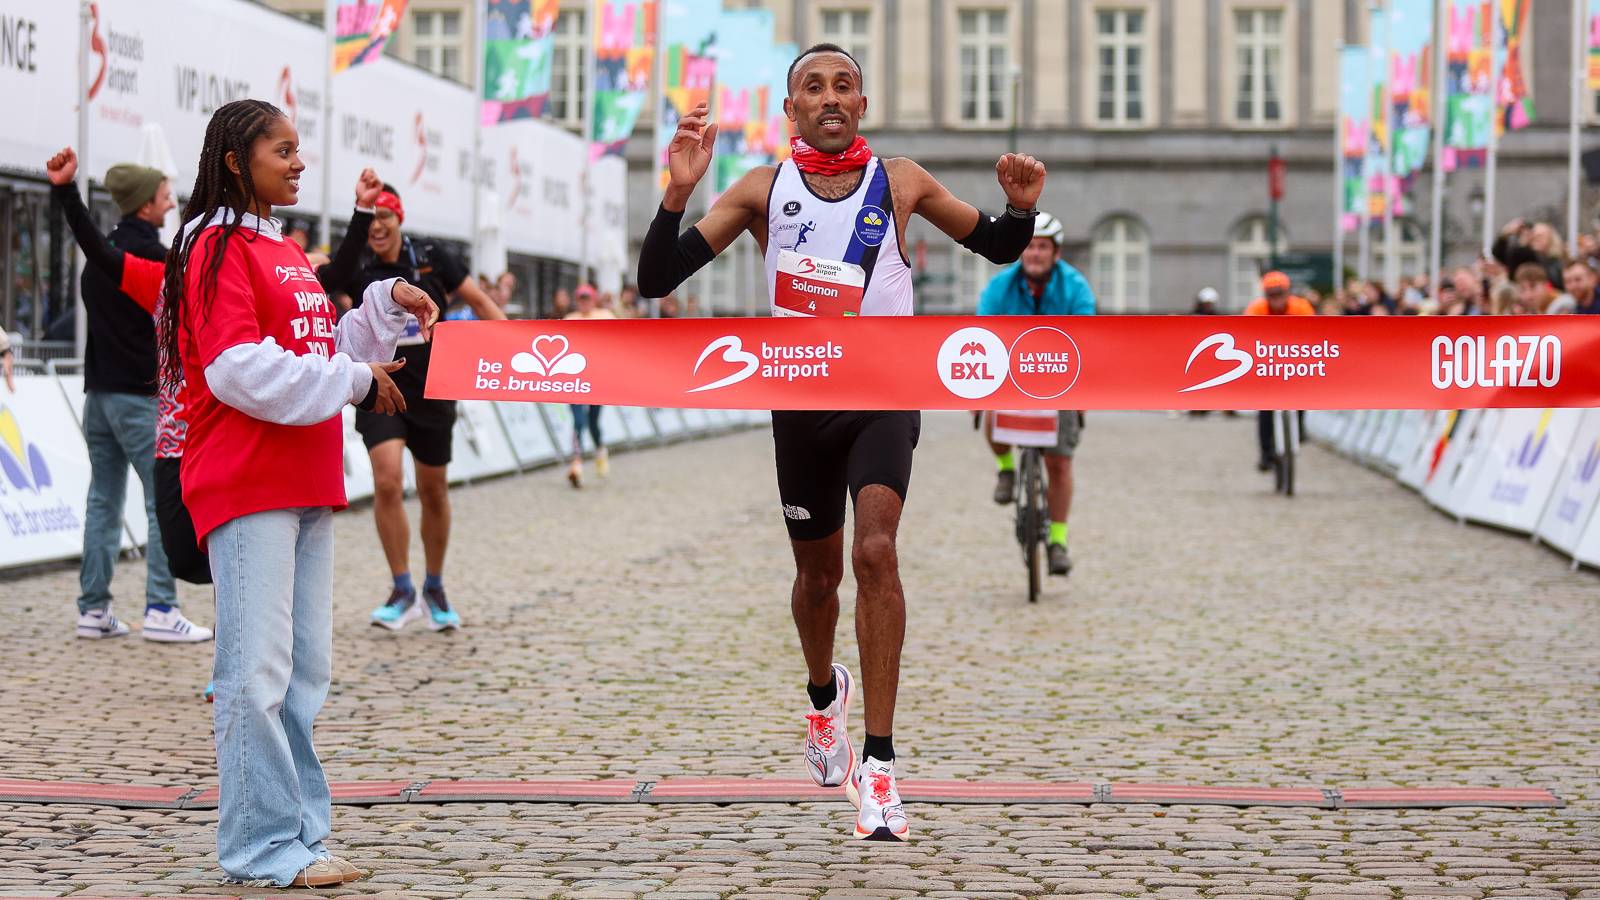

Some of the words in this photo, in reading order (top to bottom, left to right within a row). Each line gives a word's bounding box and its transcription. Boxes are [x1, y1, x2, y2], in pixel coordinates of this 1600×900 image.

[815, 268, 837, 276] airport
[792, 279, 838, 298] Solomon
[808, 300, 817, 311] 4
[761, 341, 843, 360] brussels
[1020, 353, 1036, 364] LA
[1036, 353, 1069, 364] VILLE
[1255, 340, 1340, 359] brussels
[478, 358, 503, 374] be
[761, 360, 829, 382] airport
[950, 362, 995, 380] BXL
[1020, 364, 1035, 374] DE
[1037, 364, 1068, 374] STAD
[1255, 358, 1326, 381] airport
[1431, 335, 1562, 390] GOLAZO
